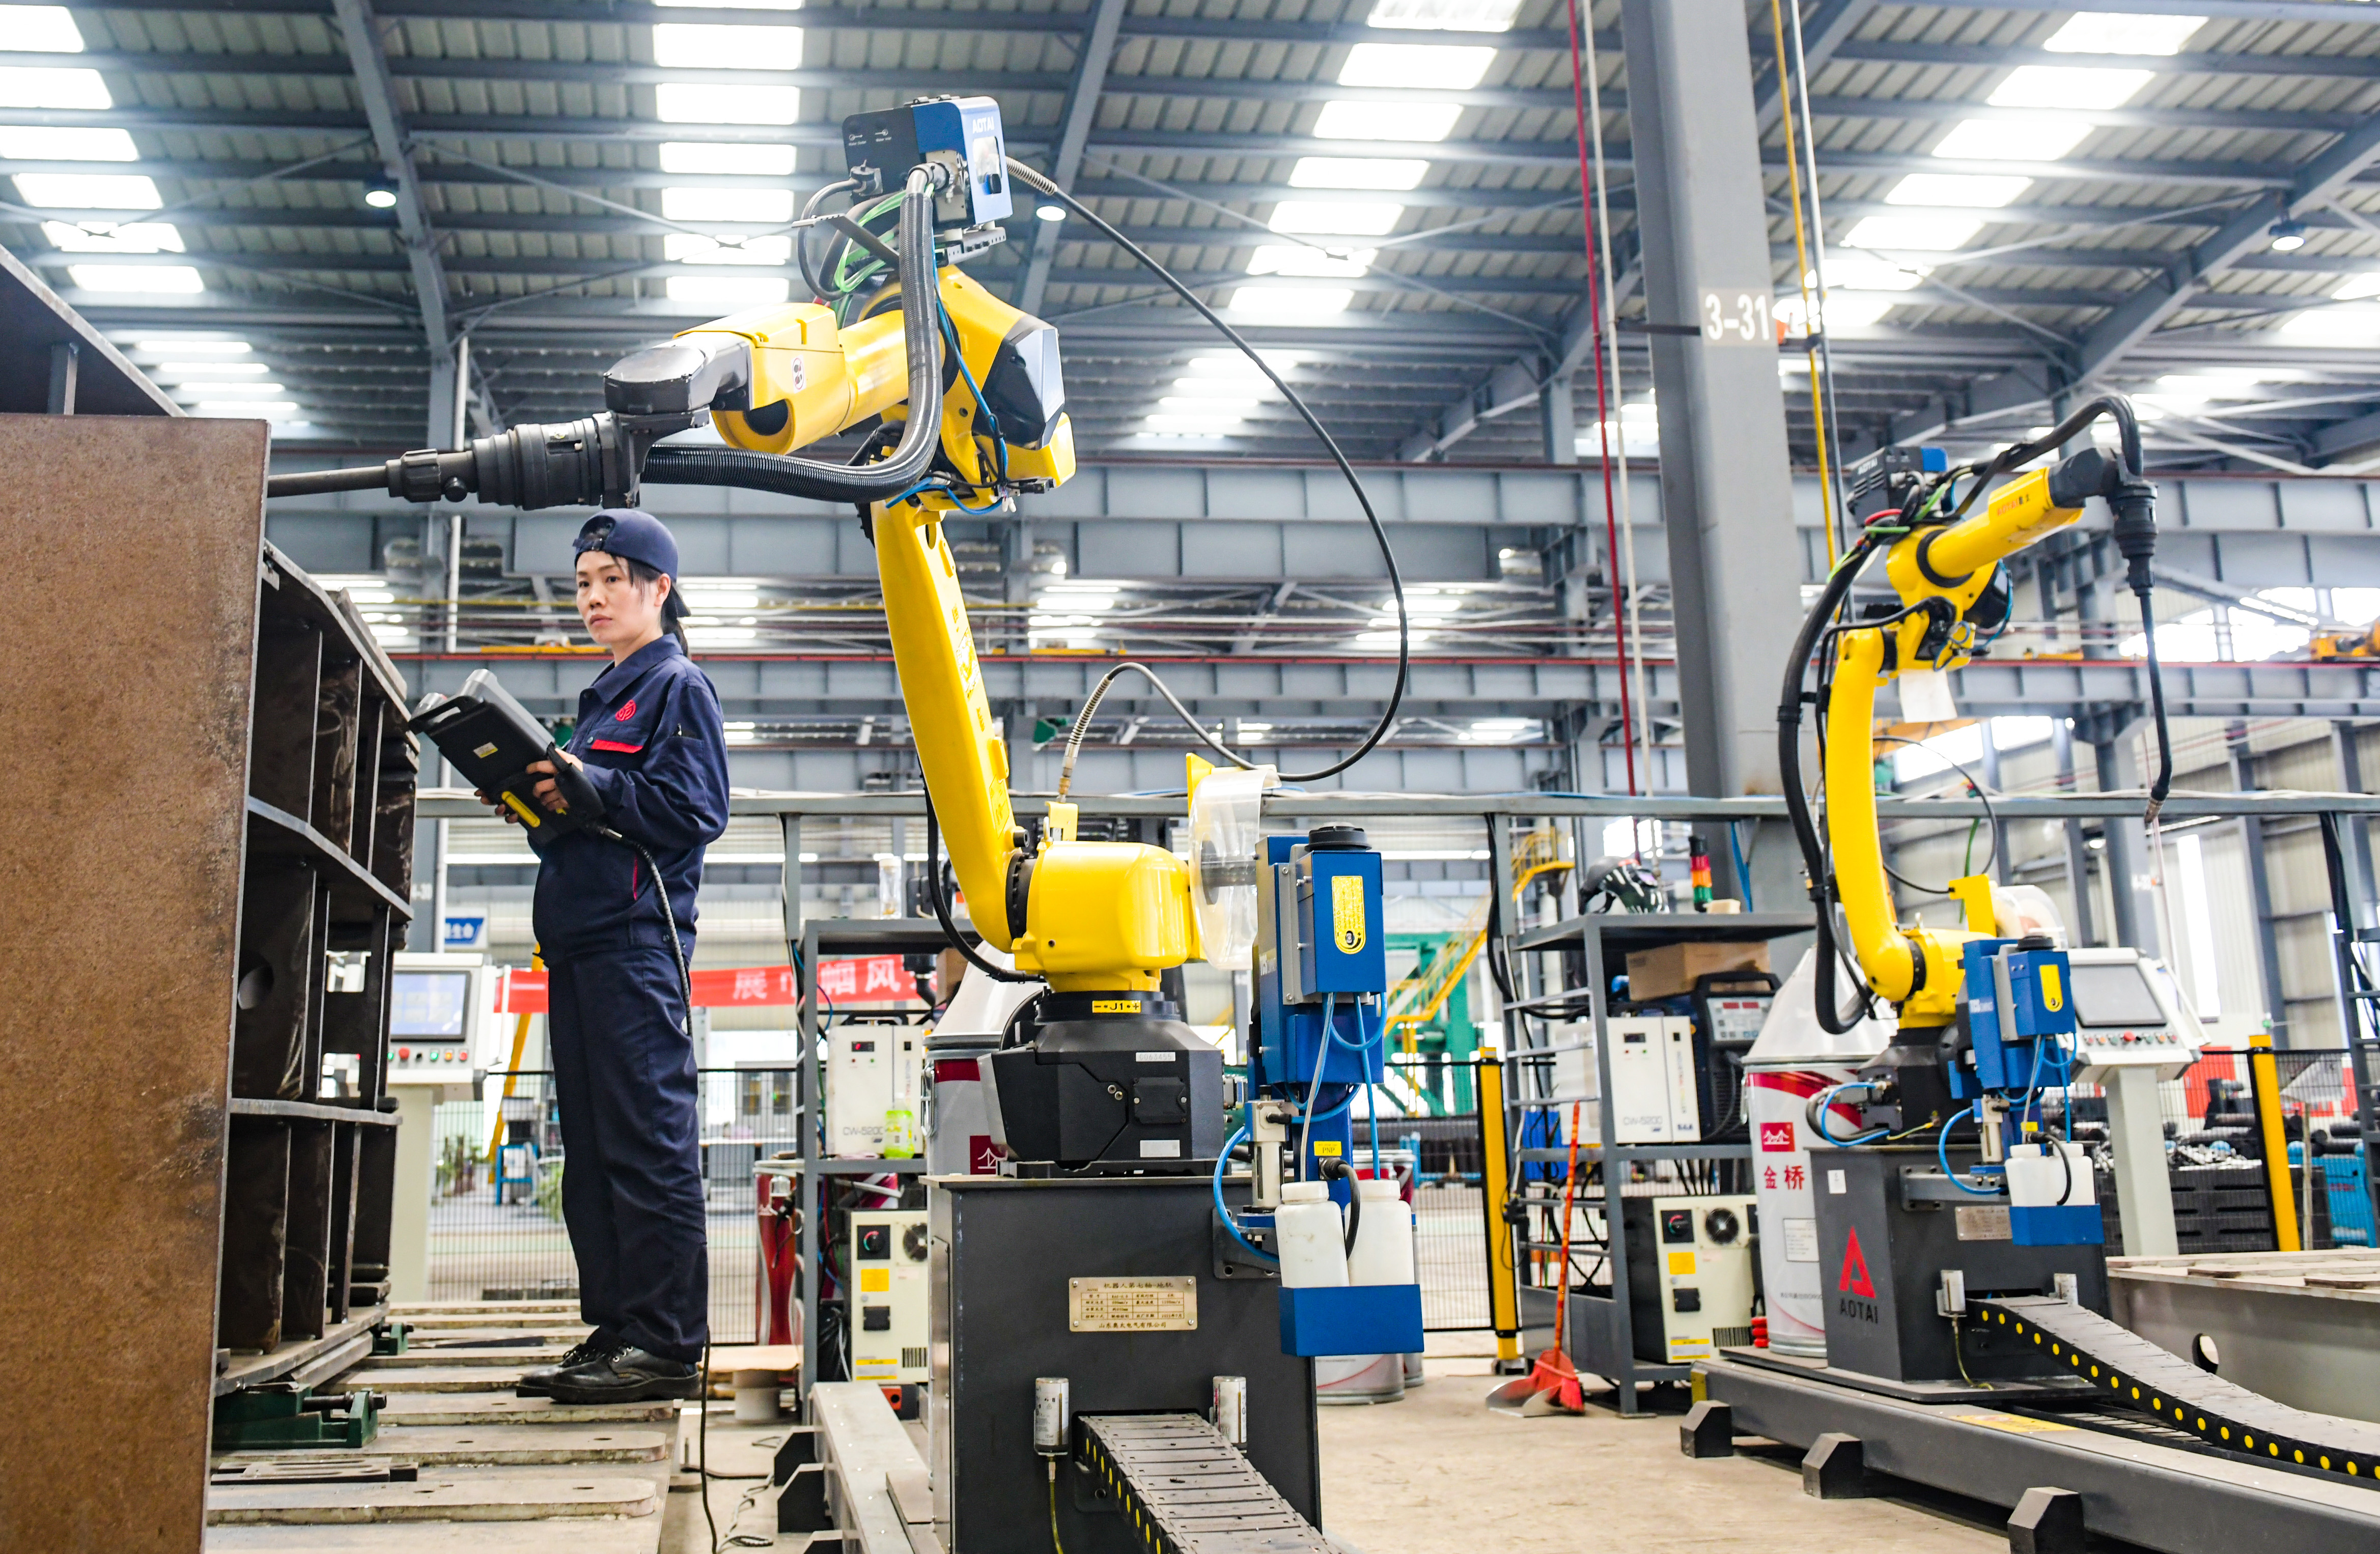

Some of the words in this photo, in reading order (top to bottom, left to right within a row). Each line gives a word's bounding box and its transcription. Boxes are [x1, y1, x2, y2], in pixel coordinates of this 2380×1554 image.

[972, 116, 994, 134] AOTAI
[1705, 293, 1770, 341] 3-31
[1764, 1165, 1805, 1191] 金桥
[1840, 1298, 1878, 1323] AOTAI
